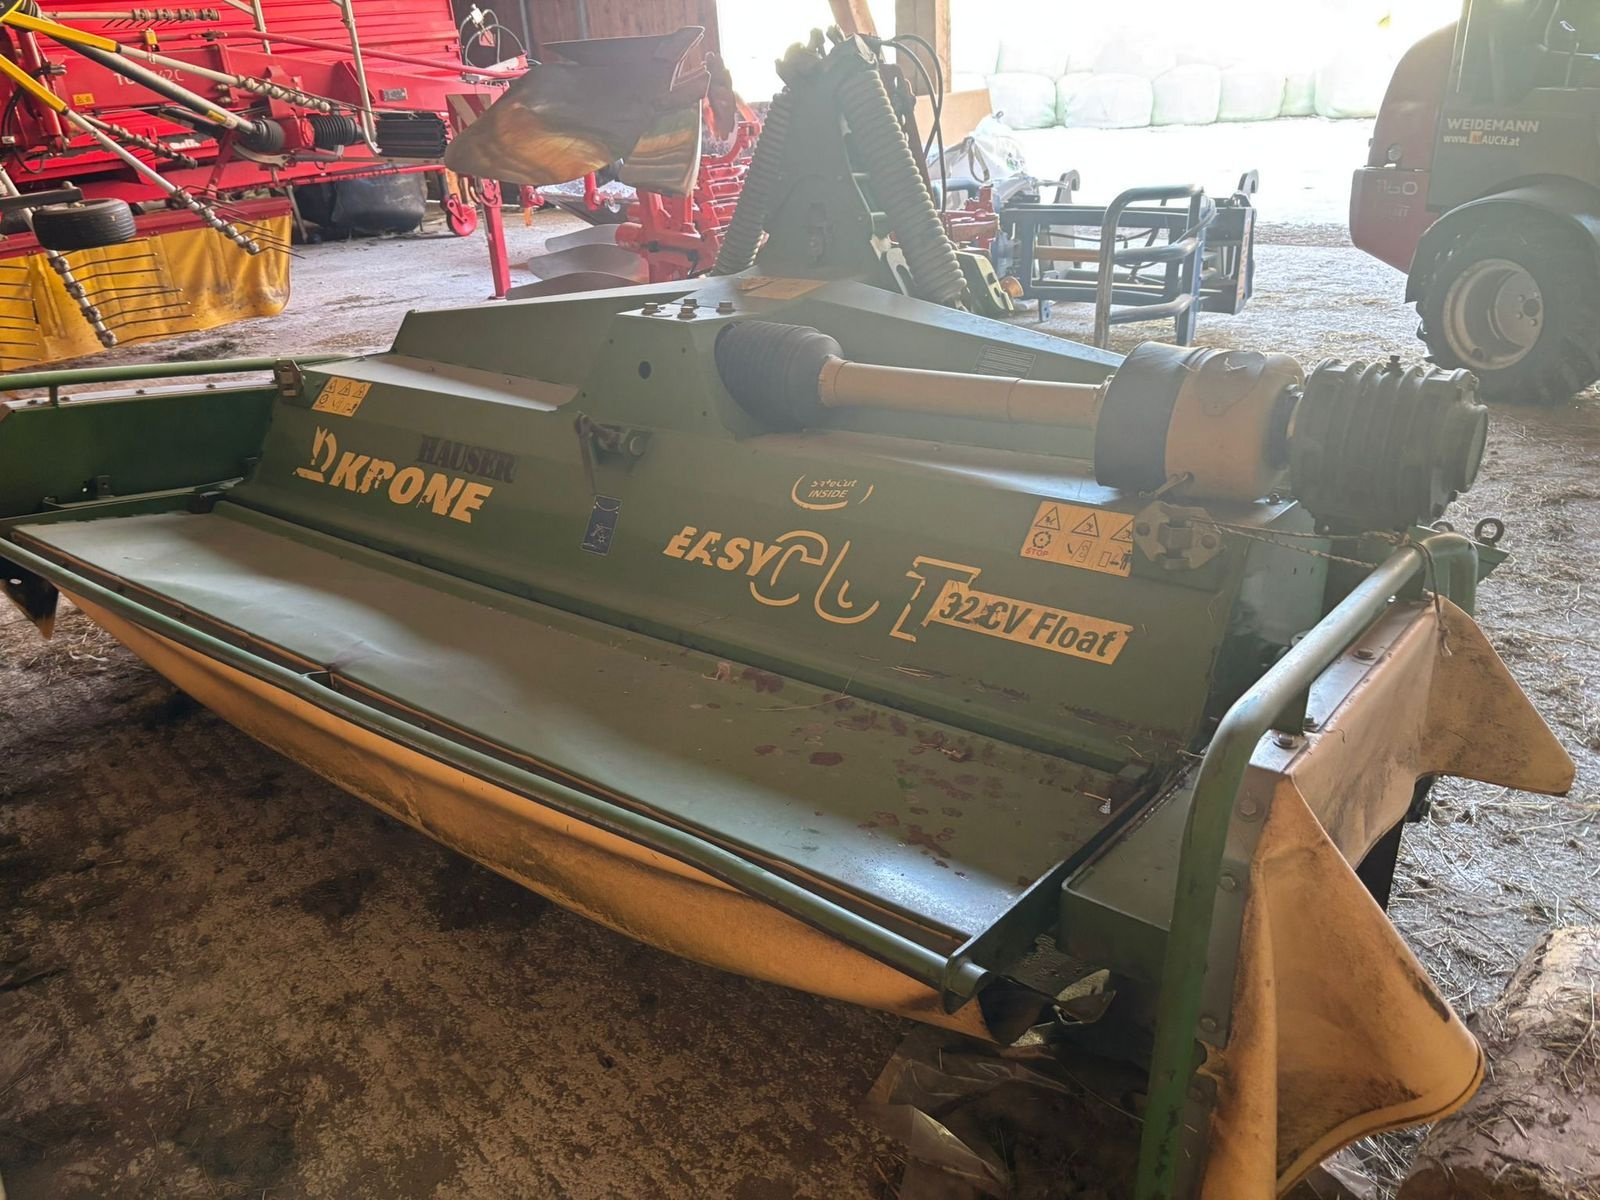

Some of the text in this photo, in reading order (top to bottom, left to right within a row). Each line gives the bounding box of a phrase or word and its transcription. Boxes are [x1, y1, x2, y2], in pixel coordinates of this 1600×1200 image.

[1447, 118, 1539, 133] WEIDEMANN
[417, 434, 518, 484] HAUSER
[329, 451, 494, 524] KRONE
[808, 489, 849, 499] INSIDE
[1025, 546, 1050, 557] STOP
[1028, 611, 1118, 658] Float
